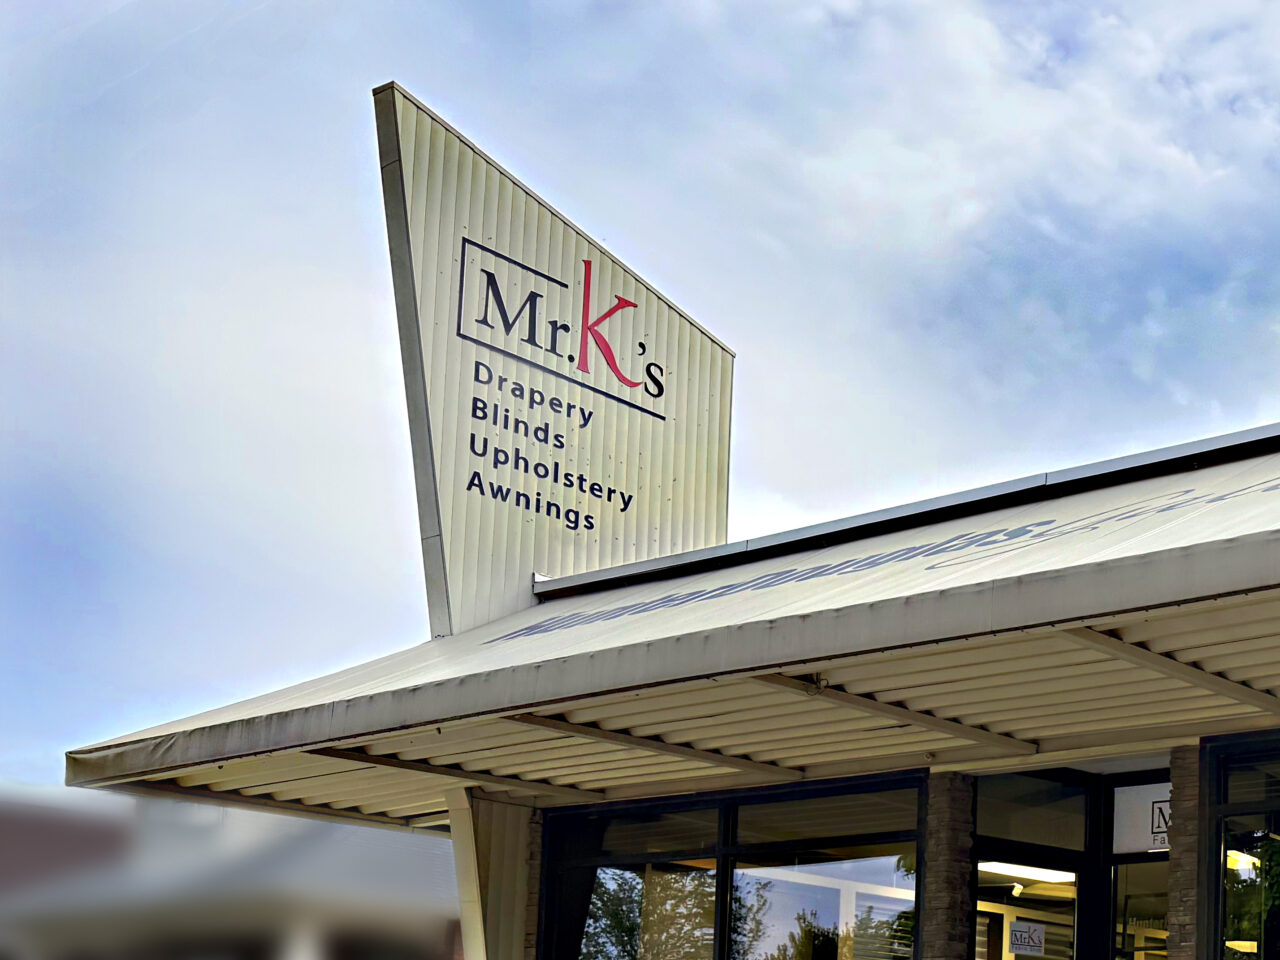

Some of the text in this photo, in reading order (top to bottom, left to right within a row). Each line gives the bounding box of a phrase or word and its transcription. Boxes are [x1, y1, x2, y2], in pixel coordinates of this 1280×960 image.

[475, 259, 664, 398] Mr.K's
[471, 396, 565, 449] Blinds
[474, 361, 594, 428] Drapery
[466, 471, 595, 530] Awnings
[469, 433, 633, 512] Upholstery
[1152, 835, 1167, 845] Fa
